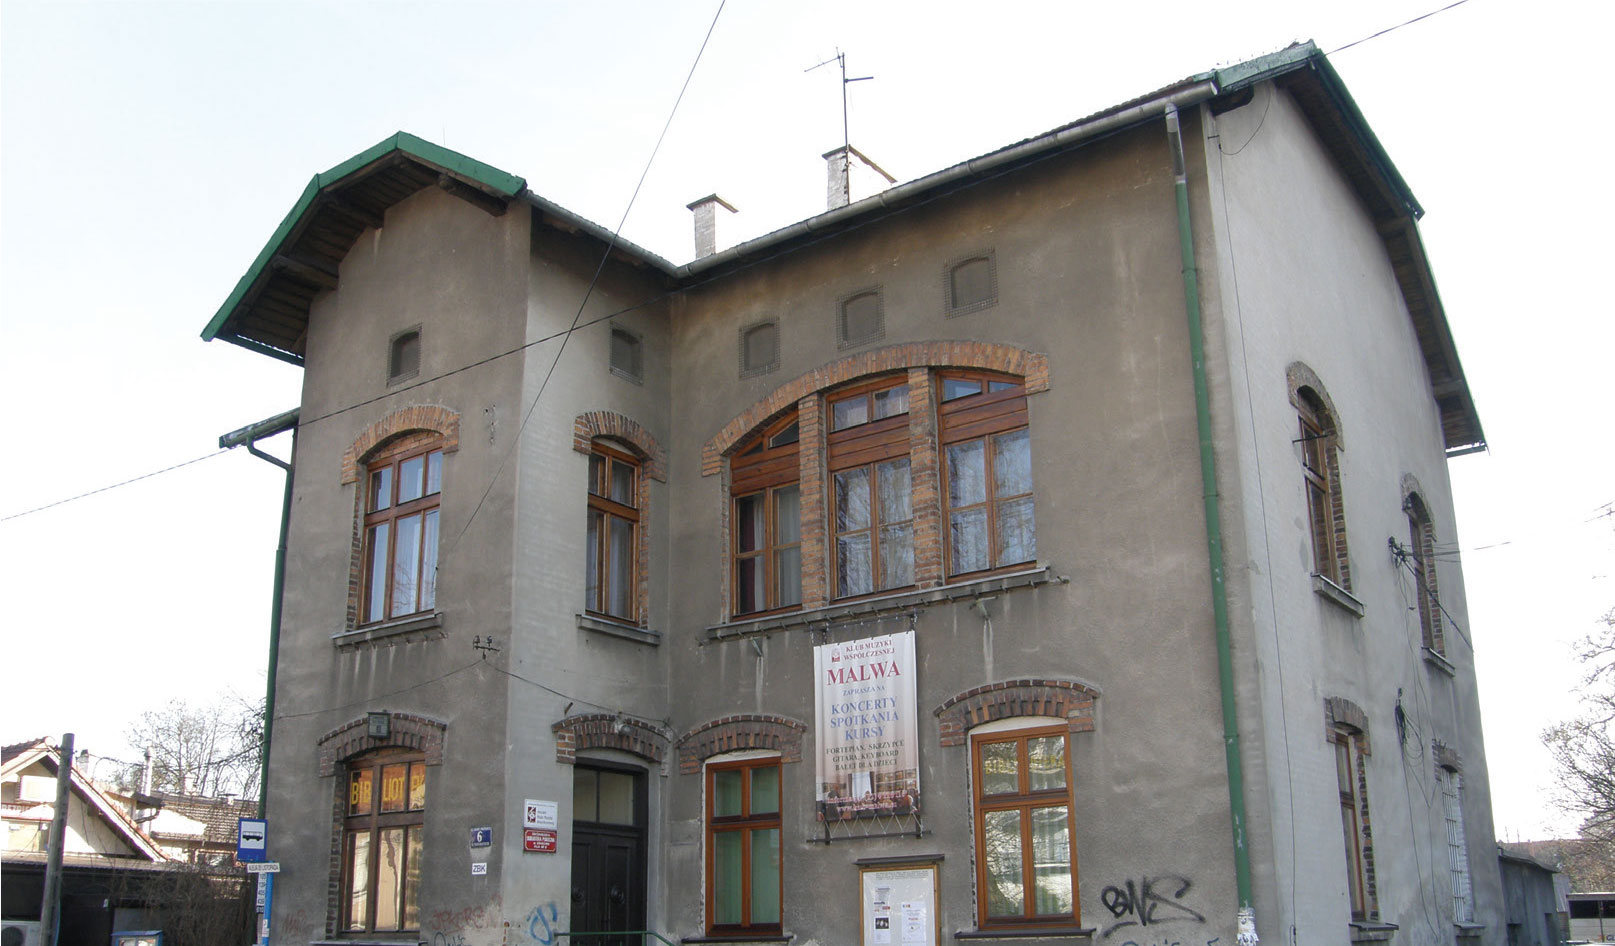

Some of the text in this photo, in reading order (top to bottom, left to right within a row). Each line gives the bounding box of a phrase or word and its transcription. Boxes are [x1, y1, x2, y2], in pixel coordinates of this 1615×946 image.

[845, 640, 892, 653] KLUB MUZYKI
[826, 660, 901, 686] MALWA
[842, 686, 876, 697] ZAPRASZA
[831, 697, 897, 715] KONCERTY
[830, 711, 899, 728] SPOTKANIA
[845, 726, 886, 741] KURSY
[868, 740, 905, 750] SKRZYPCE
[861, 750, 899, 760] KEYBOARD
[835, 758, 897, 771] BALET DLA DZIECI
[476, 830, 483, 843] 6
[473, 864, 486, 873] ZBK
